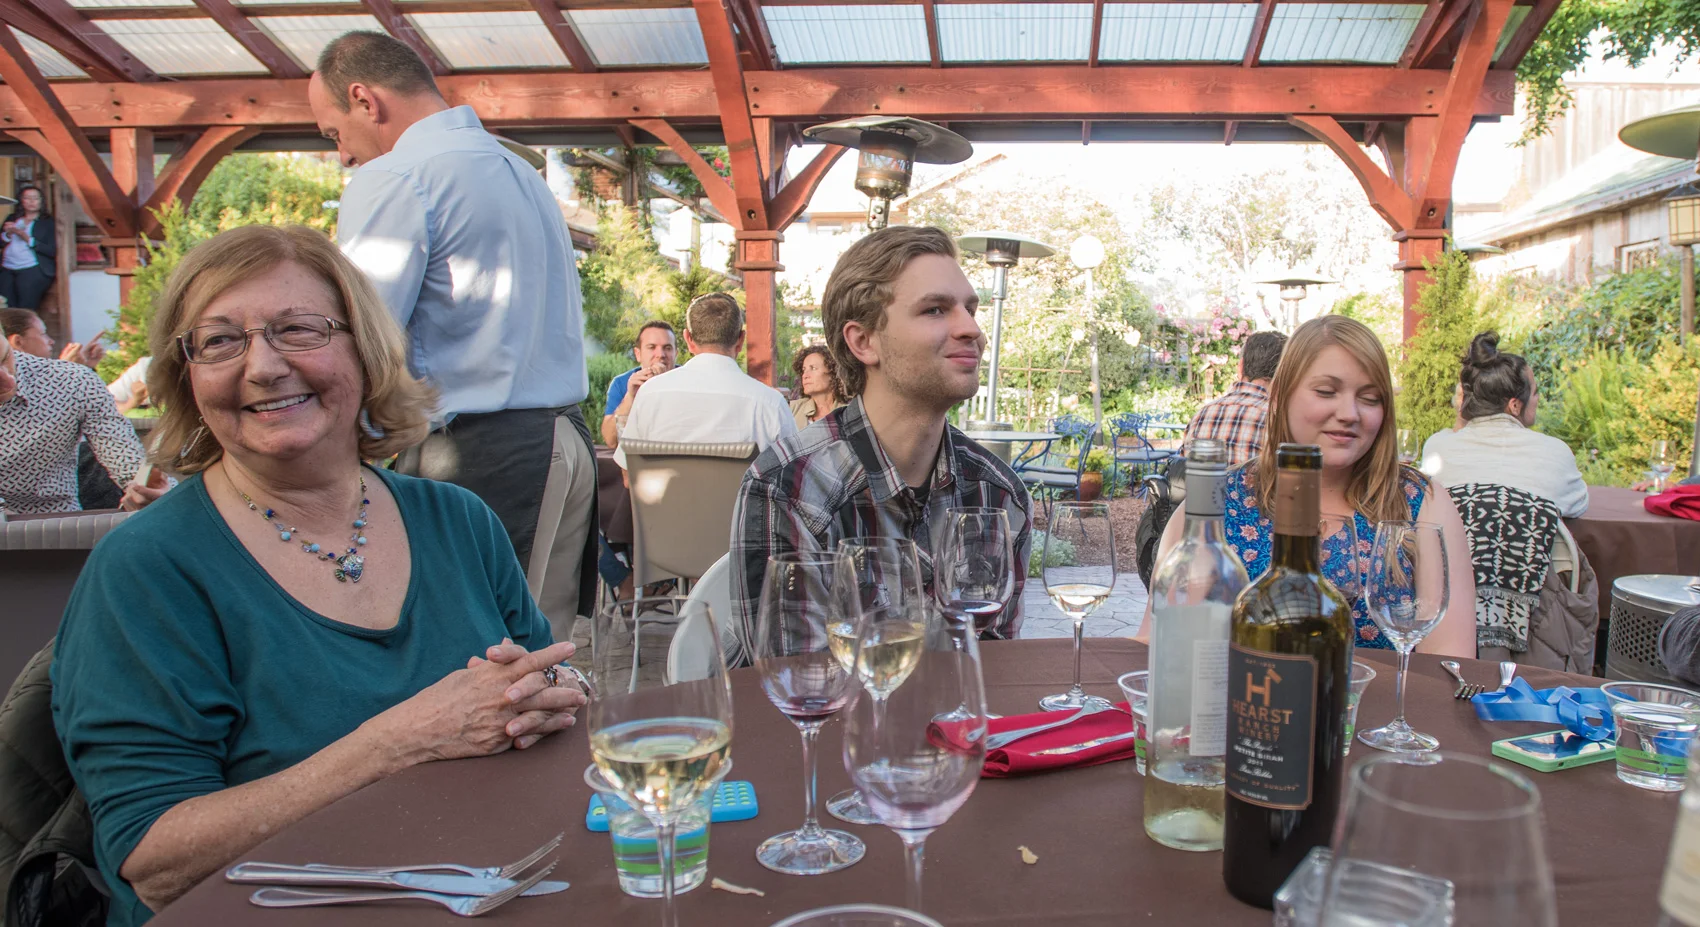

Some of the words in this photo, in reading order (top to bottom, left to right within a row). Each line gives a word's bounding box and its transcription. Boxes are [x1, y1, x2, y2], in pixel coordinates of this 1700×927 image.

[1232, 699, 1293, 726] HEARST
[1238, 717, 1280, 733] RANCH
[1238, 726, 1280, 742] WINERY
[1233, 745, 1256, 758] PETITE
[1257, 751, 1284, 763] SIRAH
